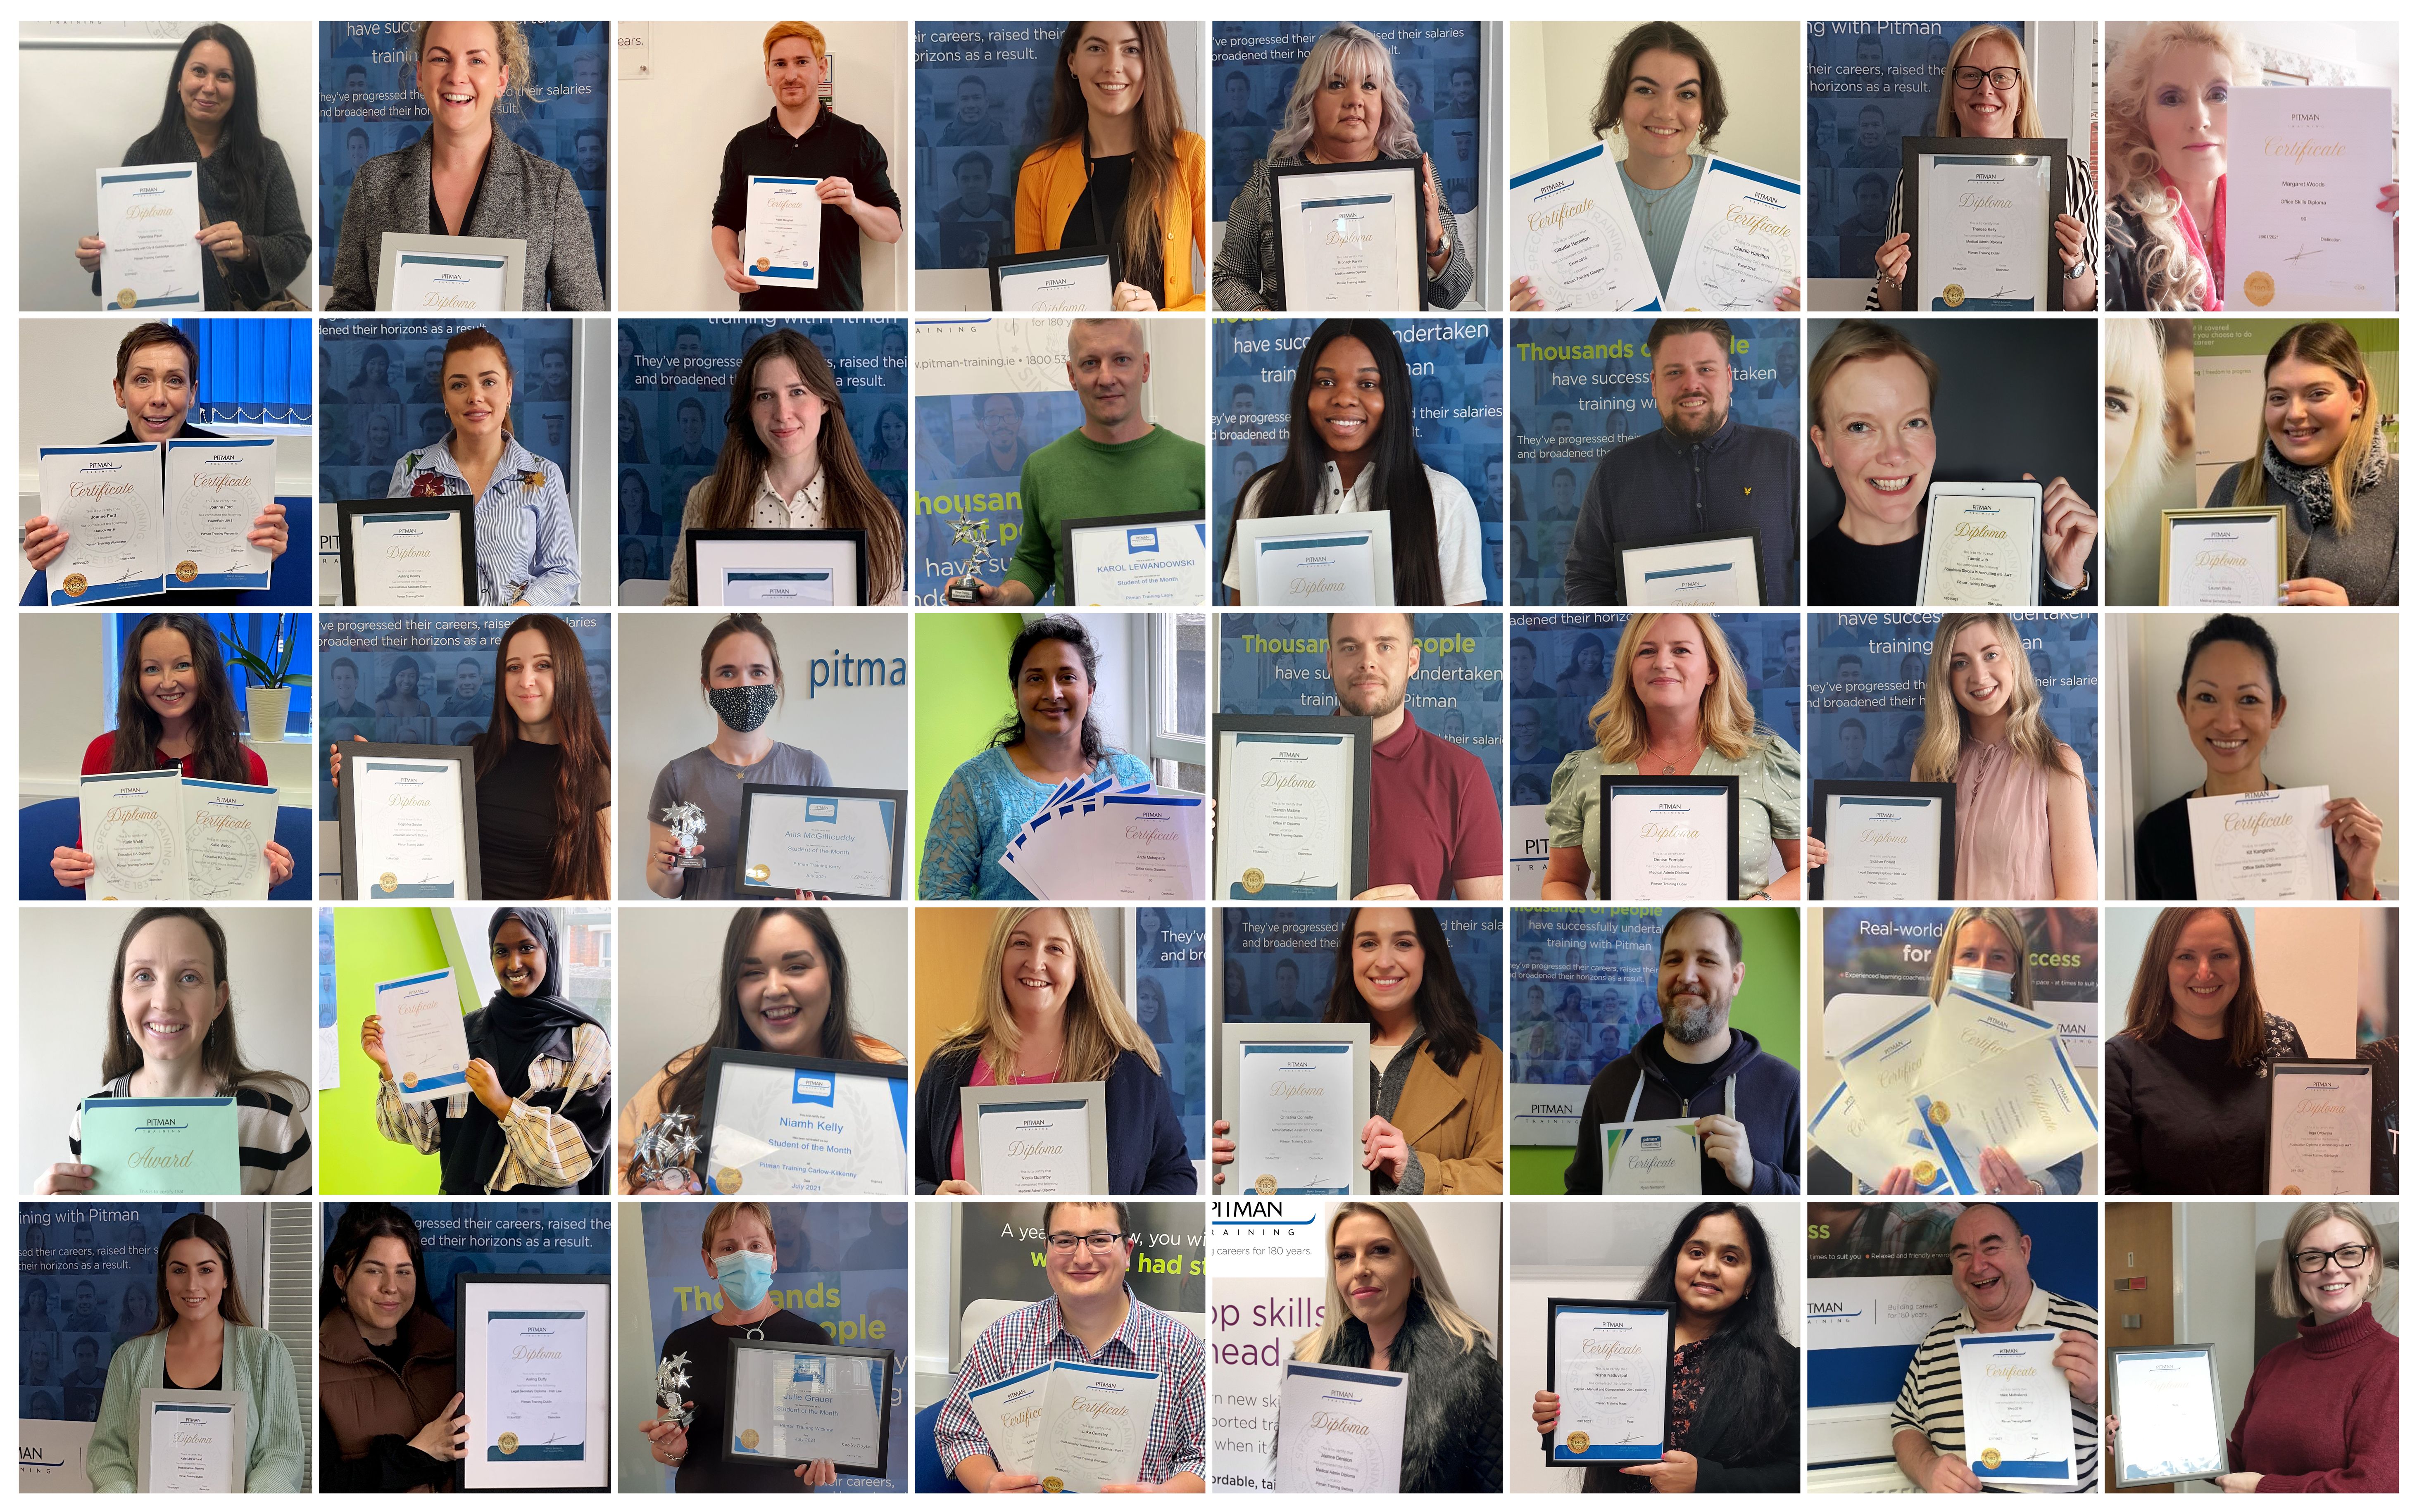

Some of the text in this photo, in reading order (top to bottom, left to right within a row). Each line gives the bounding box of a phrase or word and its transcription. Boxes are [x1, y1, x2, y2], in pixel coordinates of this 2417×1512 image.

[931, 30, 1030, 42] careers, raised
[965, 48, 1037, 61] as a result.
[1836, 64, 1924, 75] careers, raised
[1810, 81, 1931, 92] horizons as a result.
[335, 106, 411, 116] broadened their
[2265, 136, 2346, 165] Certificate
[1541, 181, 1564, 194] PITMAN
[767, 198, 803, 211] Certificate
[1958, 193, 2012, 211] Diploma
[126, 206, 173, 222] Diploma
[1527, 198, 1595, 231] Certificate
[1554, 235, 1590, 253] Claudia Hamilton
[423, 292, 476, 311] Diploma
[352, 323, 428, 335] their horizons
[1517, 340, 1633, 361] Thousands
[635, 355, 680, 368] They've
[635, 373, 726, 385] and broadened
[1420, 407, 1502, 419] their salaries
[70, 482, 134, 502] Certificate
[1954, 522, 2007, 541] Diploma
[386, 545, 431, 559] Diploma
[2195, 551, 2247, 569] Diploma
[1129, 559, 1194, 571] LEWANDOWSKI
[1290, 578, 1345, 597] Diploma
[338, 619, 481, 632] progressed their careers,
[810, 649, 906, 699] pitma
[1275, 666, 1310, 679] have
[1824, 696, 1917, 707] broadened their
[1261, 771, 1316, 791] Diploma
[107, 807, 158, 825] Diploma
[2224, 812, 2293, 836] Certificate
[804, 832, 854, 842] McGillicuddy
[1125, 826, 1179, 846] Certificate
[1640, 823, 1699, 842] Diploma
[1242, 922, 1338, 934] They've progressed
[1529, 920, 1618, 934] have successfully
[1860, 921, 1943, 937] Real-world
[1547, 939, 1651, 952] training with Pitman
[1903, 945, 1932, 962] for
[1161, 949, 1185, 961] and
[398, 1001, 438, 1017] Certificate
[1532, 1105, 1572, 1114] PITMAN
[2297, 1100, 2346, 1116] Diploma
[780, 1117, 843, 1134] Niamh Kelly
[768, 1139, 799, 1149] Student
[811, 1143, 824, 1152] the
[826, 1145, 851, 1154] Month
[1008, 1140, 1063, 1160] Diploma
[128, 1147, 194, 1168] Award
[1629, 1156, 1676, 1174] Certificate
[55, 1210, 139, 1223] with Pitman
[464, 1218, 586, 1230] their careers, raised
[1002, 1223, 1013, 1237] A
[1217, 1246, 1312, 1257] careers for 180 years.
[1139, 1253, 1182, 1275] had
[1582, 1339, 1642, 1360] Certificate
[1986, 1364, 2037, 1381] Certificate
[805, 1395, 833, 1403] Grauer
[1072, 1396, 1129, 1419] Certificate
[1311, 1412, 1370, 1436] Diploma
[846, 1477, 894, 1488] careers,
